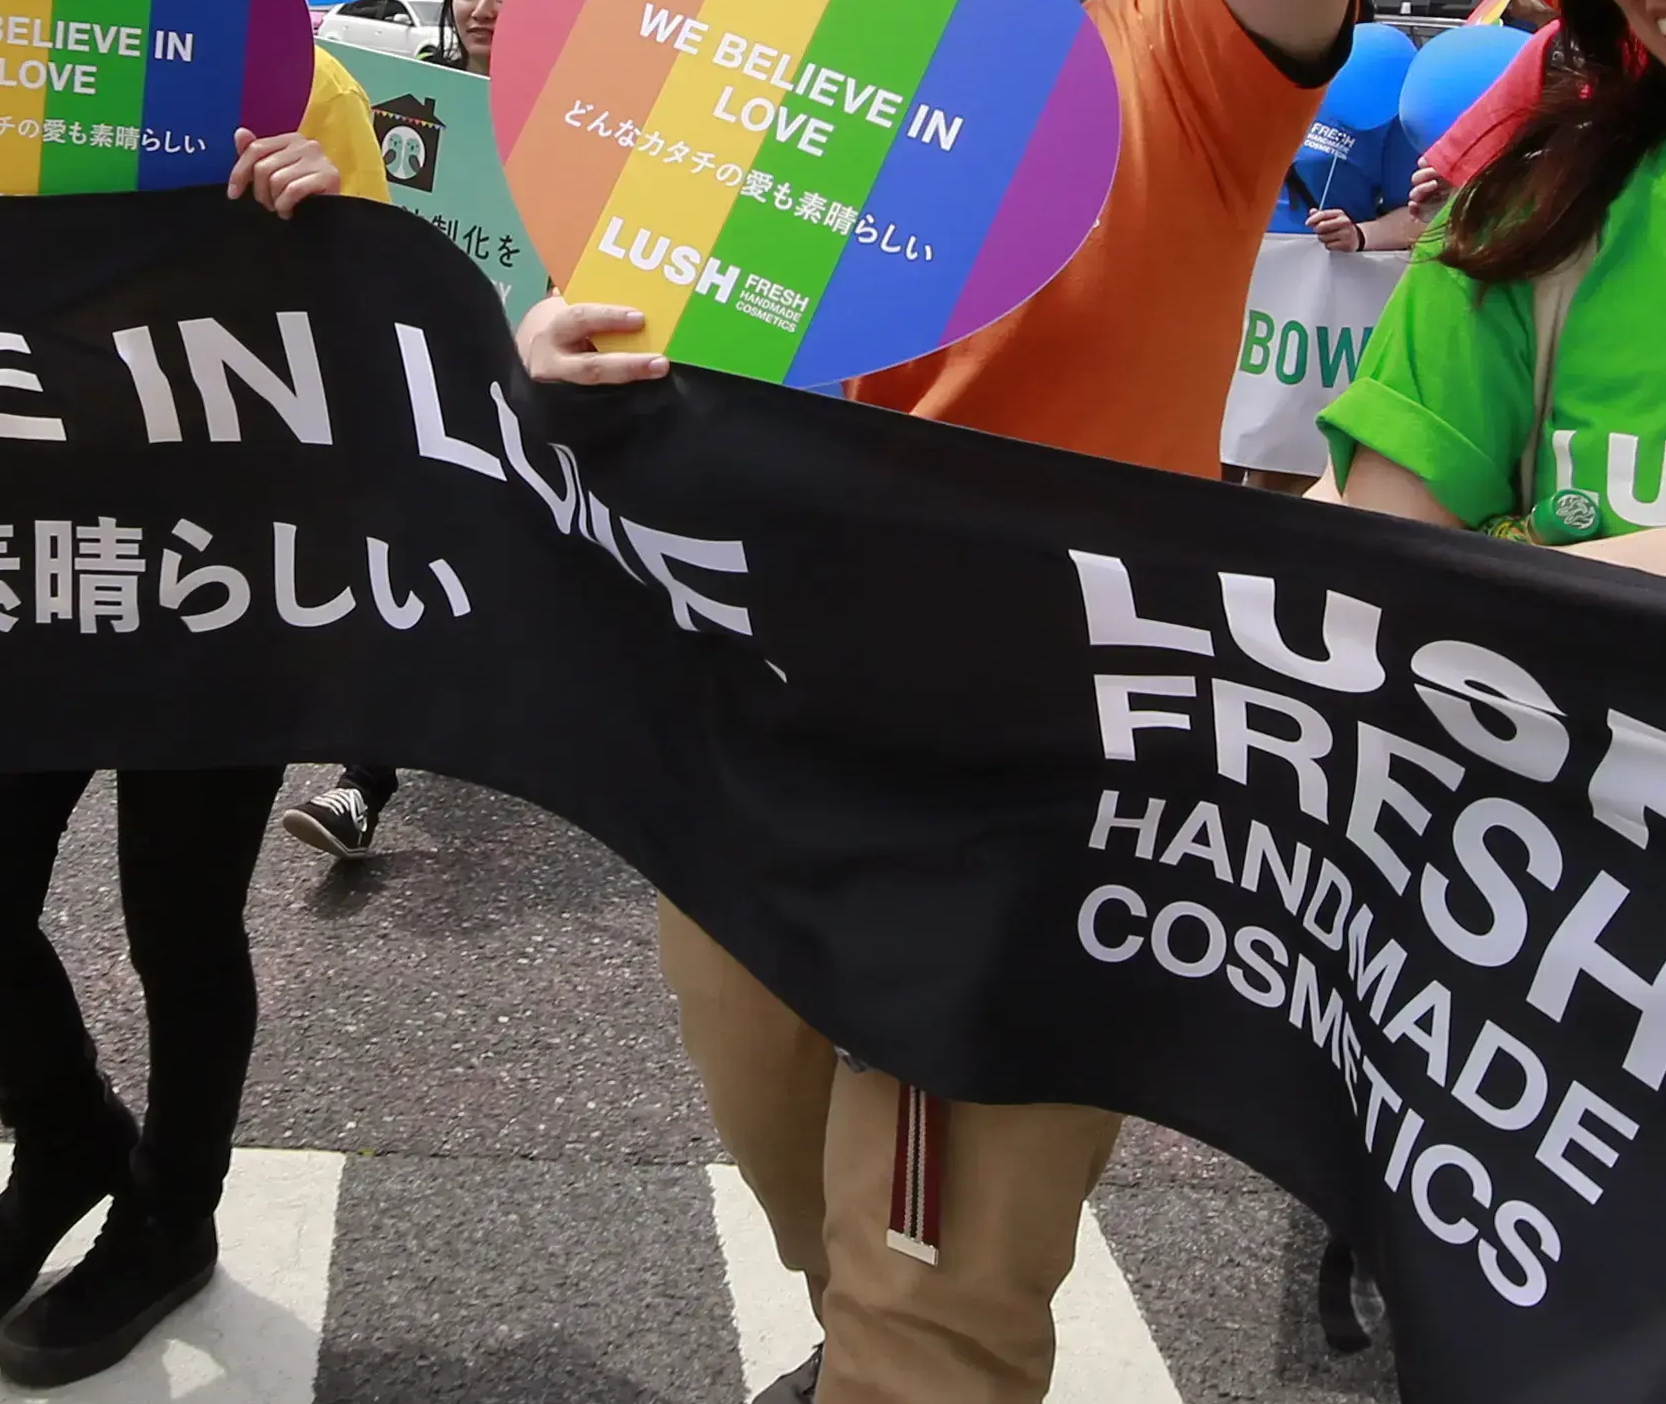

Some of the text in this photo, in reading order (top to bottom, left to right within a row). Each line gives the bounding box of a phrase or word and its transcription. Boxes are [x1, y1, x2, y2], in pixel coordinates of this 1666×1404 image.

[152, 29, 194, 62] IN
[638, 2, 964, 153] WE BELIEVE IN
[562, 98, 934, 262] どんなカタチの愛も素晴らしい
[712, 85, 836, 158] LOVE
[596, 216, 810, 313] LUSH FRESH
[735, 300, 797, 333] COSMETICS
[739, 289, 802, 323] HANDMADE
[112, 309, 336, 446] IN
[1088, 789, 1640, 1206] HANDMADE
[1077, 884, 1562, 1308] COSMETICS
